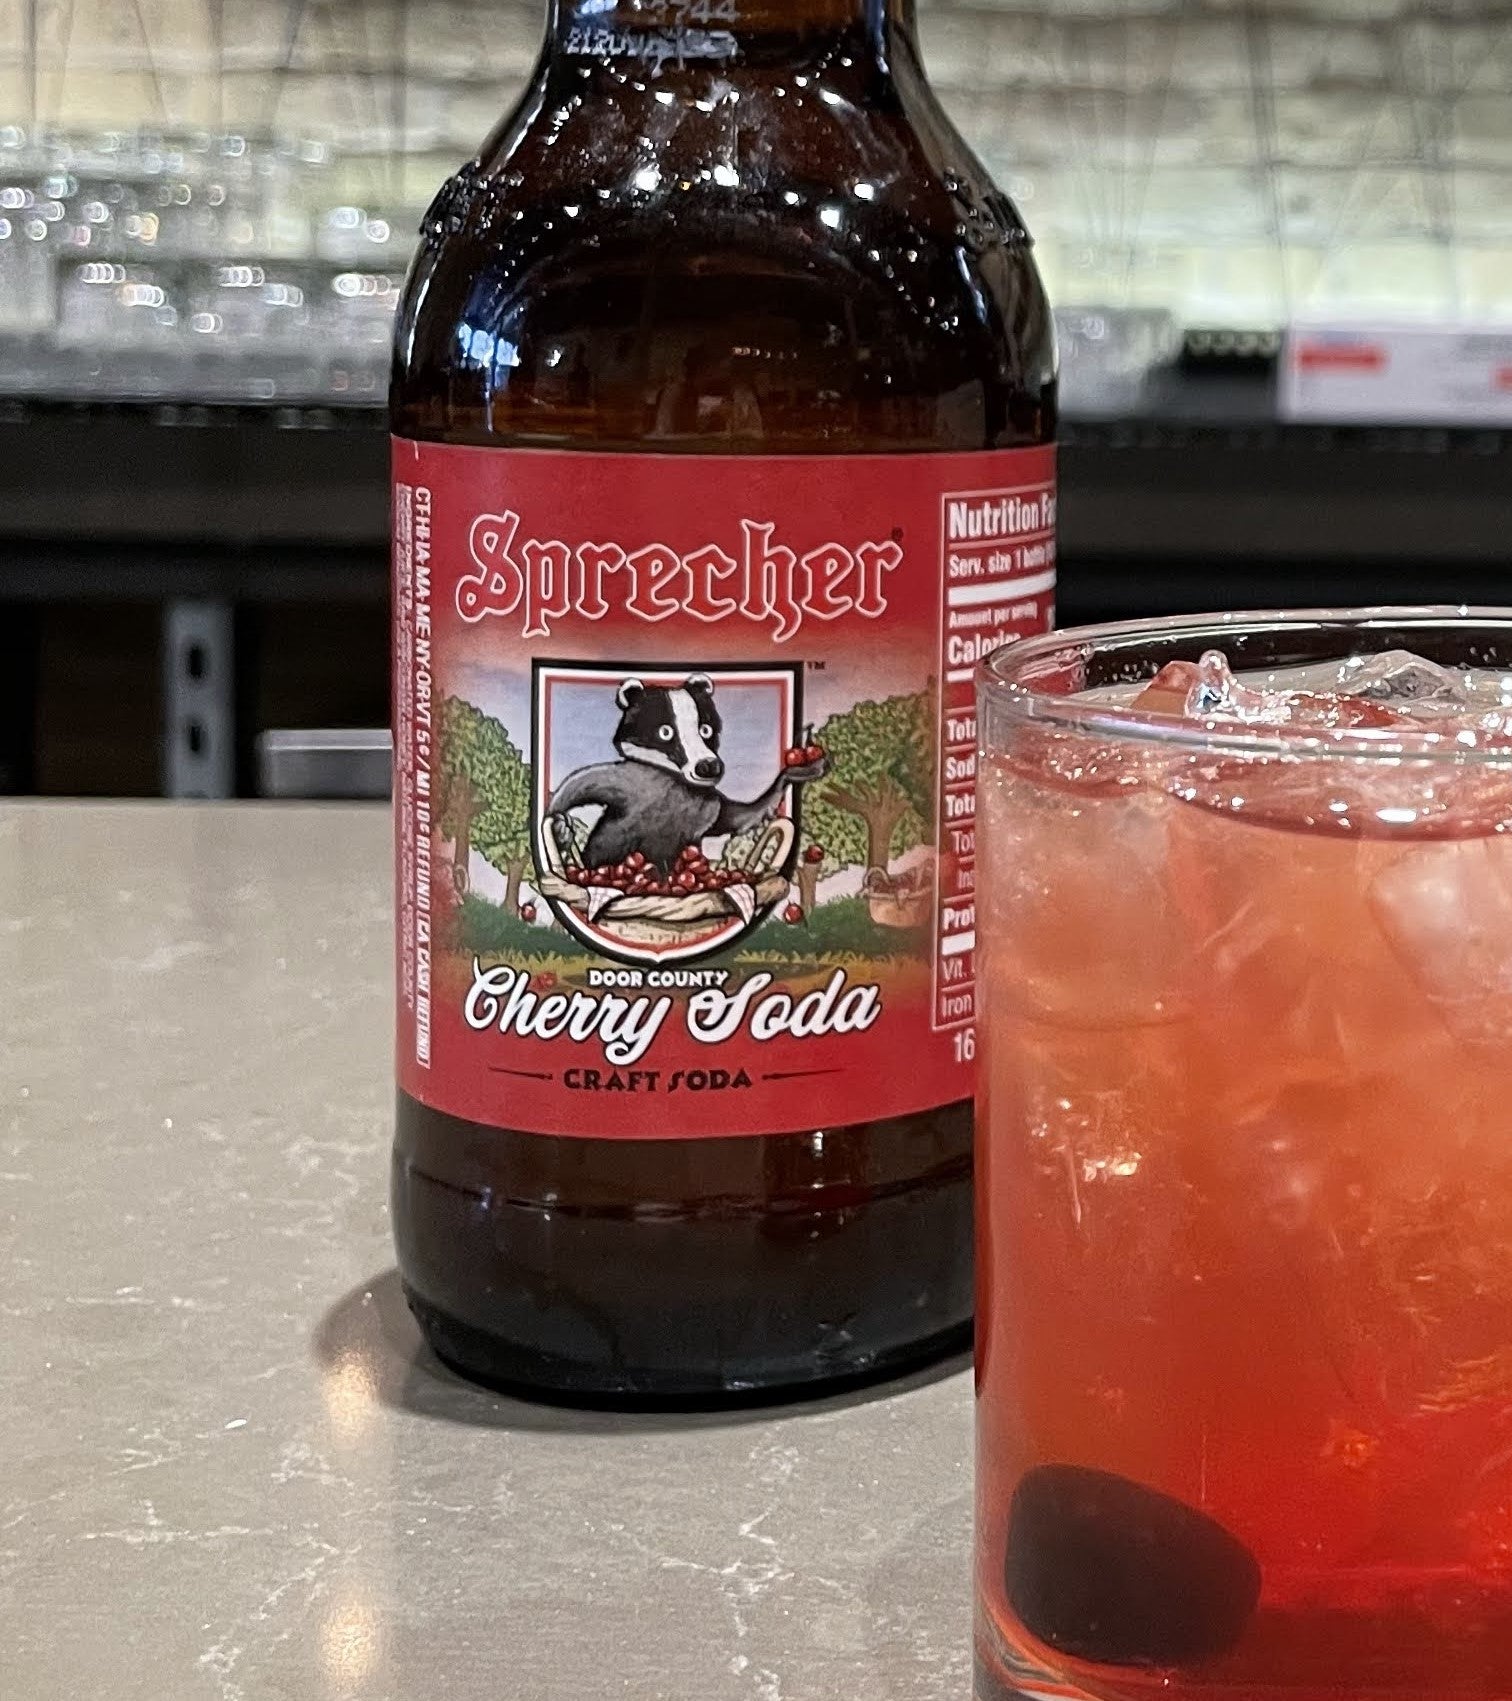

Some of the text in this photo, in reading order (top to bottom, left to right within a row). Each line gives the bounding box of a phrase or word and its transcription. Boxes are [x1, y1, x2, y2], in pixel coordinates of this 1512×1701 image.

[947, 496, 1040, 540] Nutrition
[455, 509, 904, 643] Sprecher
[949, 554, 986, 577] Serv.
[416, 834, 431, 911] REFUND
[588, 969, 729, 988] DOOR COUNTY
[463, 955, 882, 1066] Cherry Soda
[941, 992, 973, 1018] Iron
[563, 1068, 753, 1093] CRAFT SODA
